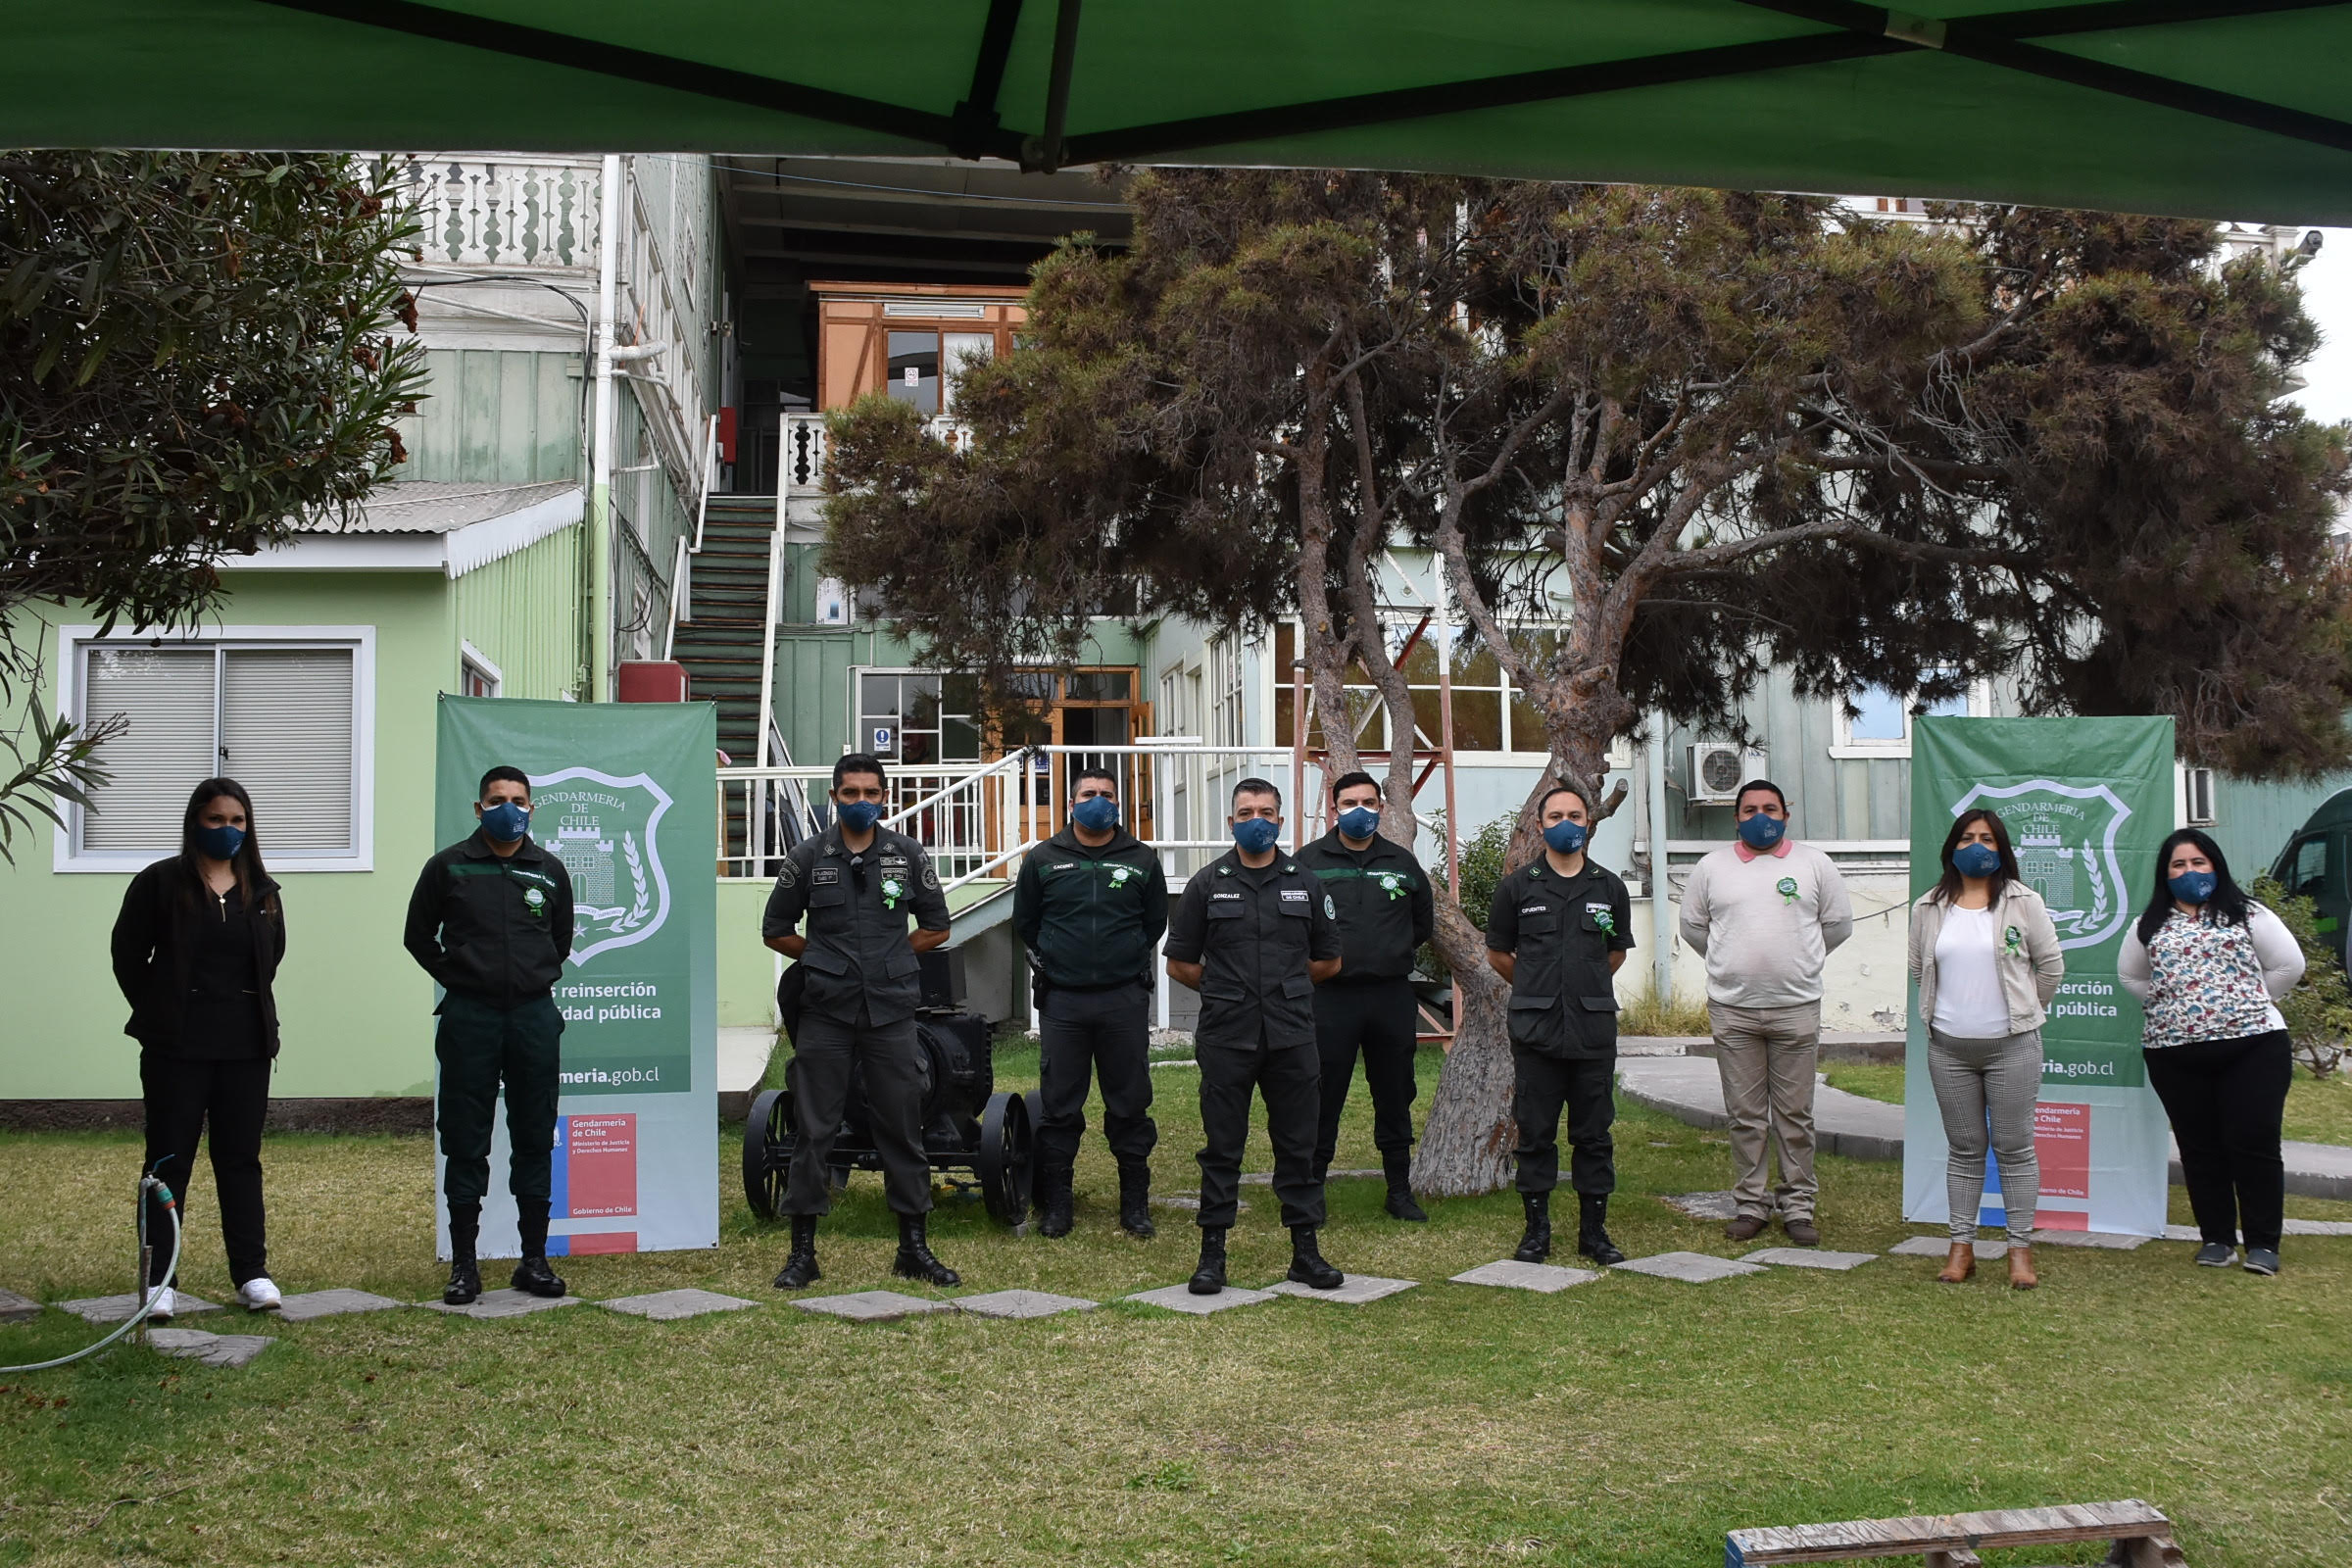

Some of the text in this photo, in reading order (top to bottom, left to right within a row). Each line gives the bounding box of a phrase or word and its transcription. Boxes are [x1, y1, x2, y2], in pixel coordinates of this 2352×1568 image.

[531, 791, 626, 811] GENDARMERIA
[571, 804, 588, 813] DE
[1995, 802, 2084, 820] GENDARMERIA
[2033, 812, 2049, 822] DE
[560, 815, 599, 826] CHILE
[2022, 824, 2060, 834] CHILE
[561, 982, 657, 998] reinserción
[2055, 981, 2113, 996] serción
[599, 1004, 661, 1023] pública
[2056, 1002, 2117, 1018] pública
[2041, 1059, 2115, 1077] ria.gob.cl
[560, 1066, 660, 1087] meria.gob.cl
[572, 1206, 604, 1215] Gobierno
